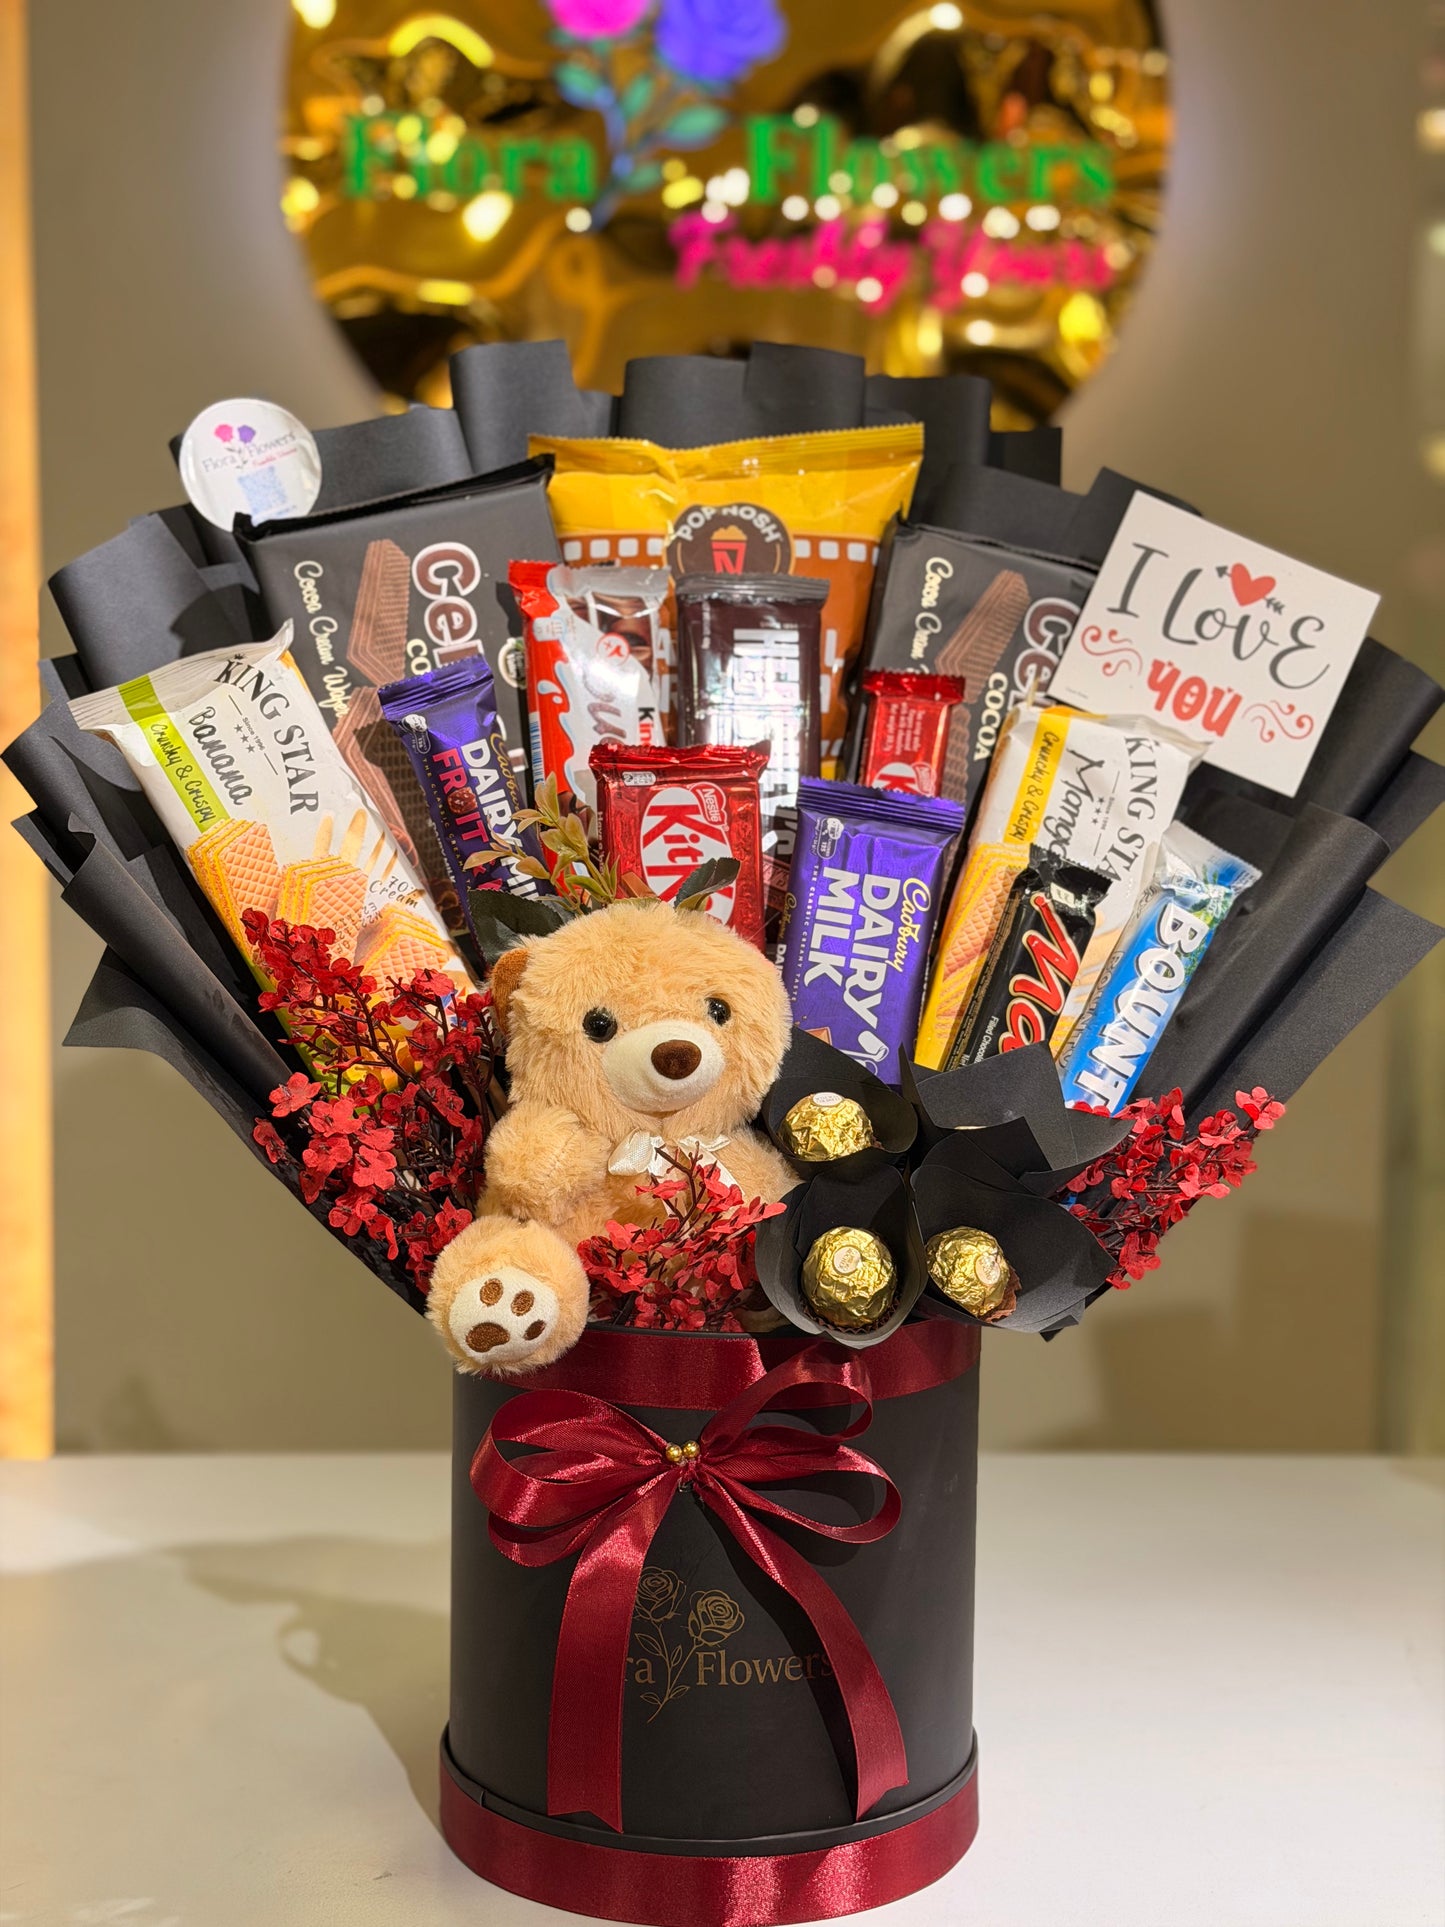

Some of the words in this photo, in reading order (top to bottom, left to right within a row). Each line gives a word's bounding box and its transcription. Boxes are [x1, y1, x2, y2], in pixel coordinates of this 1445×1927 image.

[344, 115, 599, 201] Flora
[748, 116, 1114, 201] Flowers
[677, 504, 718, 542] POP
[721, 505, 782, 543] NOSH
[1107, 542, 1169, 620] I
[318, 666, 352, 719] Wafer
[972, 671, 1009, 762] COCOA
[150, 723, 183, 768] Crunchy
[175, 764, 193, 781] &
[185, 779, 217, 823] Crispy
[188, 706, 253, 806] Banana
[213, 659, 290, 721] KING
[274, 724, 321, 815] STAR
[490, 733, 519, 812] Cadbur
[1029, 731, 1060, 783] Crunchy
[423, 758, 432, 778] THE
[431, 783, 450, 828] CLASSIC
[461, 739, 523, 848] DAIRY
[1026, 785, 1043, 797] &
[1124, 736, 1158, 820] KING
[1009, 799, 1039, 841] Crispy
[1094, 827, 1145, 881] STA
[369, 880, 419, 908] Cream
[803, 866, 860, 987] MILK
[804, 887, 815, 926] CLASSIC
[885, 877, 932, 972] Cadbury
[797, 931, 808, 968] CREAMY
[843, 873, 901, 1029] DAIRY
[1074, 906, 1209, 1113] BOUNT
